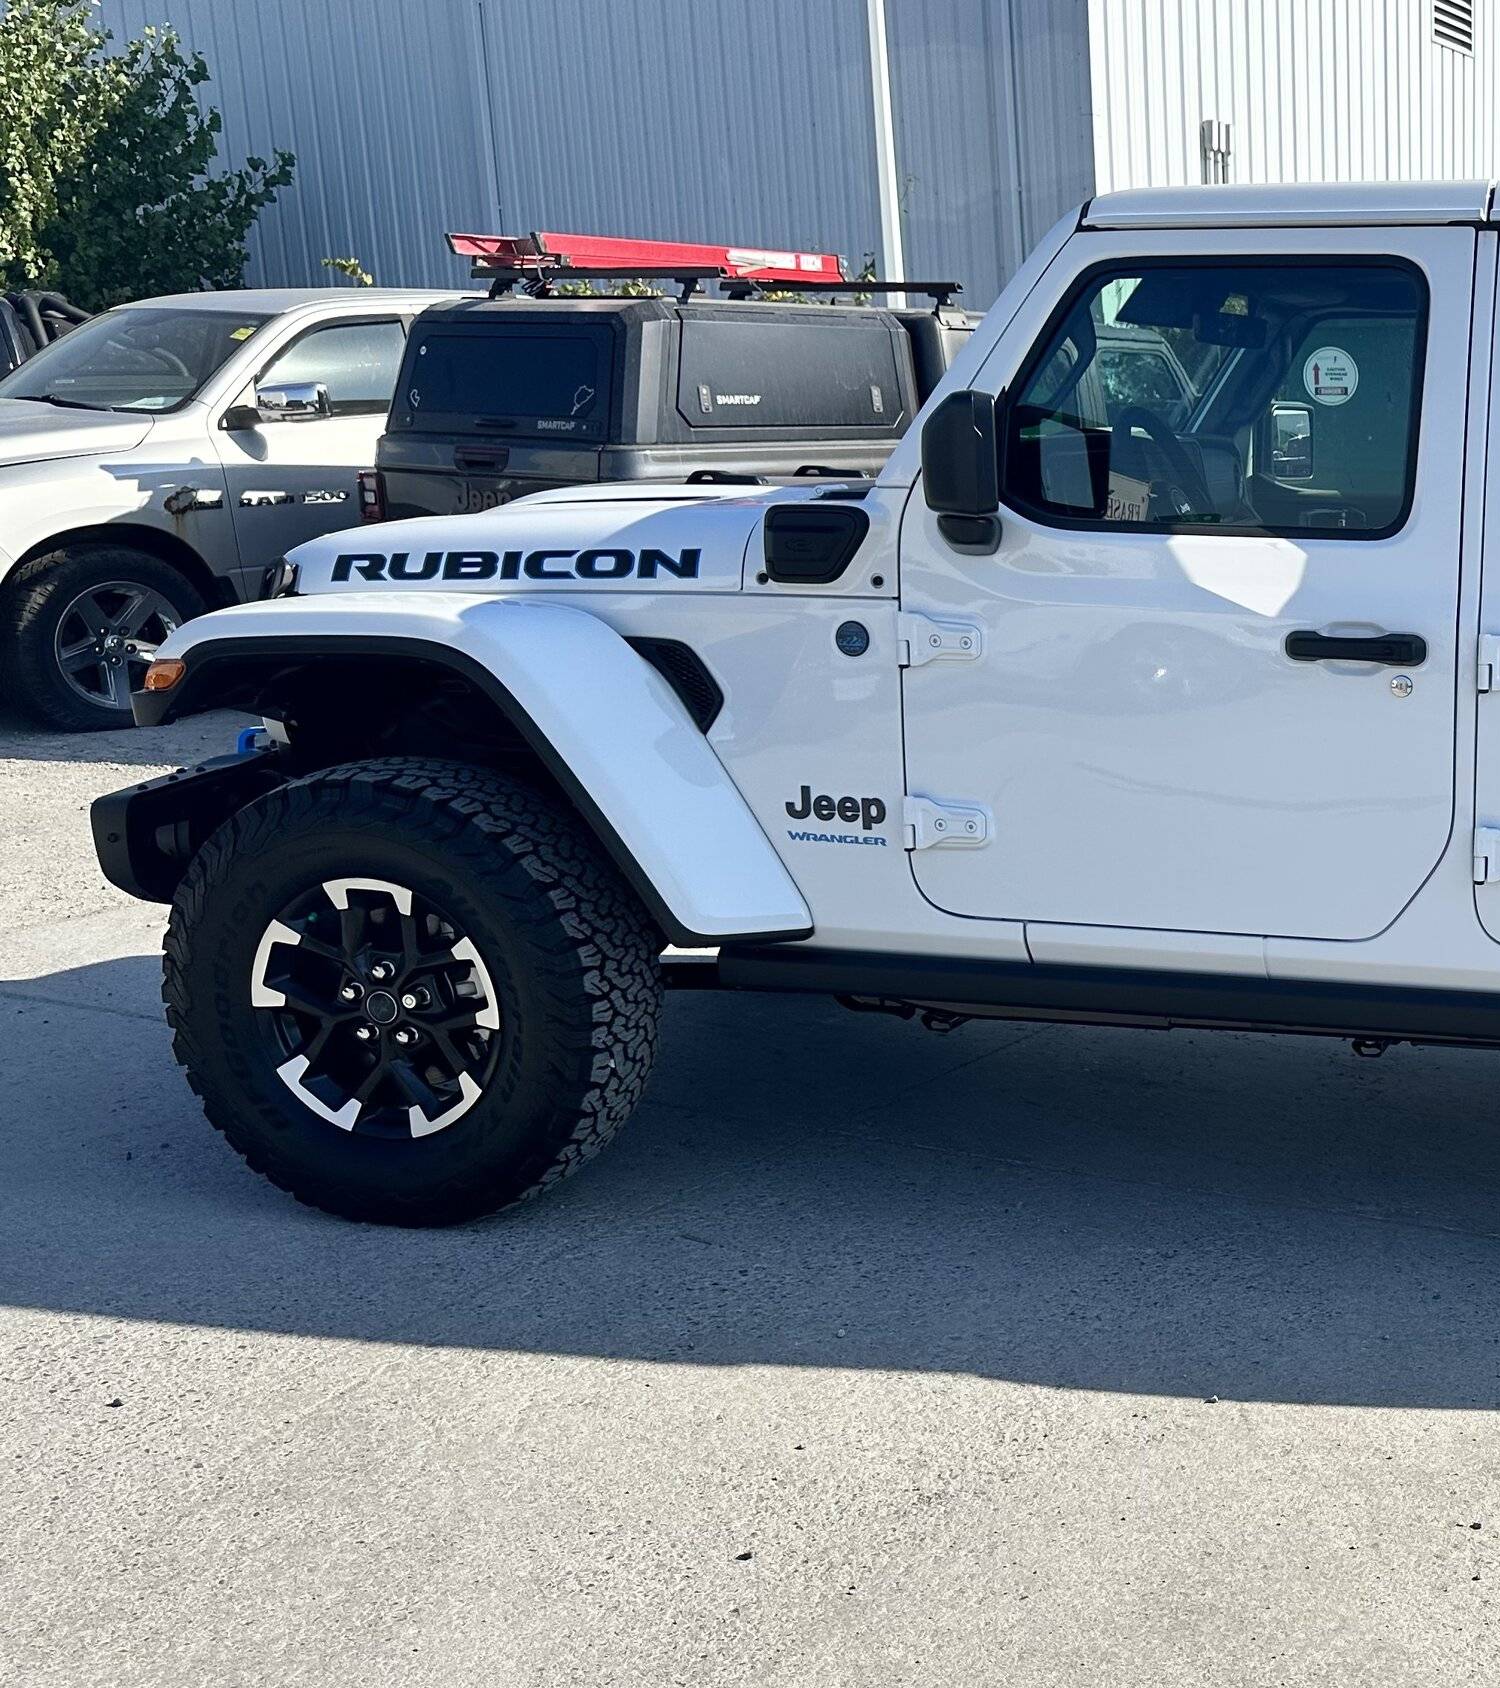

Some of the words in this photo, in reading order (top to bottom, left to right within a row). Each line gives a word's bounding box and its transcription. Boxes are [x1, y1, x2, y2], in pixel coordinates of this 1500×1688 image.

[537, 420, 576, 431] SMARTCAP
[331, 548, 702, 582] RUBICON
[785, 785, 886, 830] Jeep
[787, 830, 887, 846] WRANGLER
